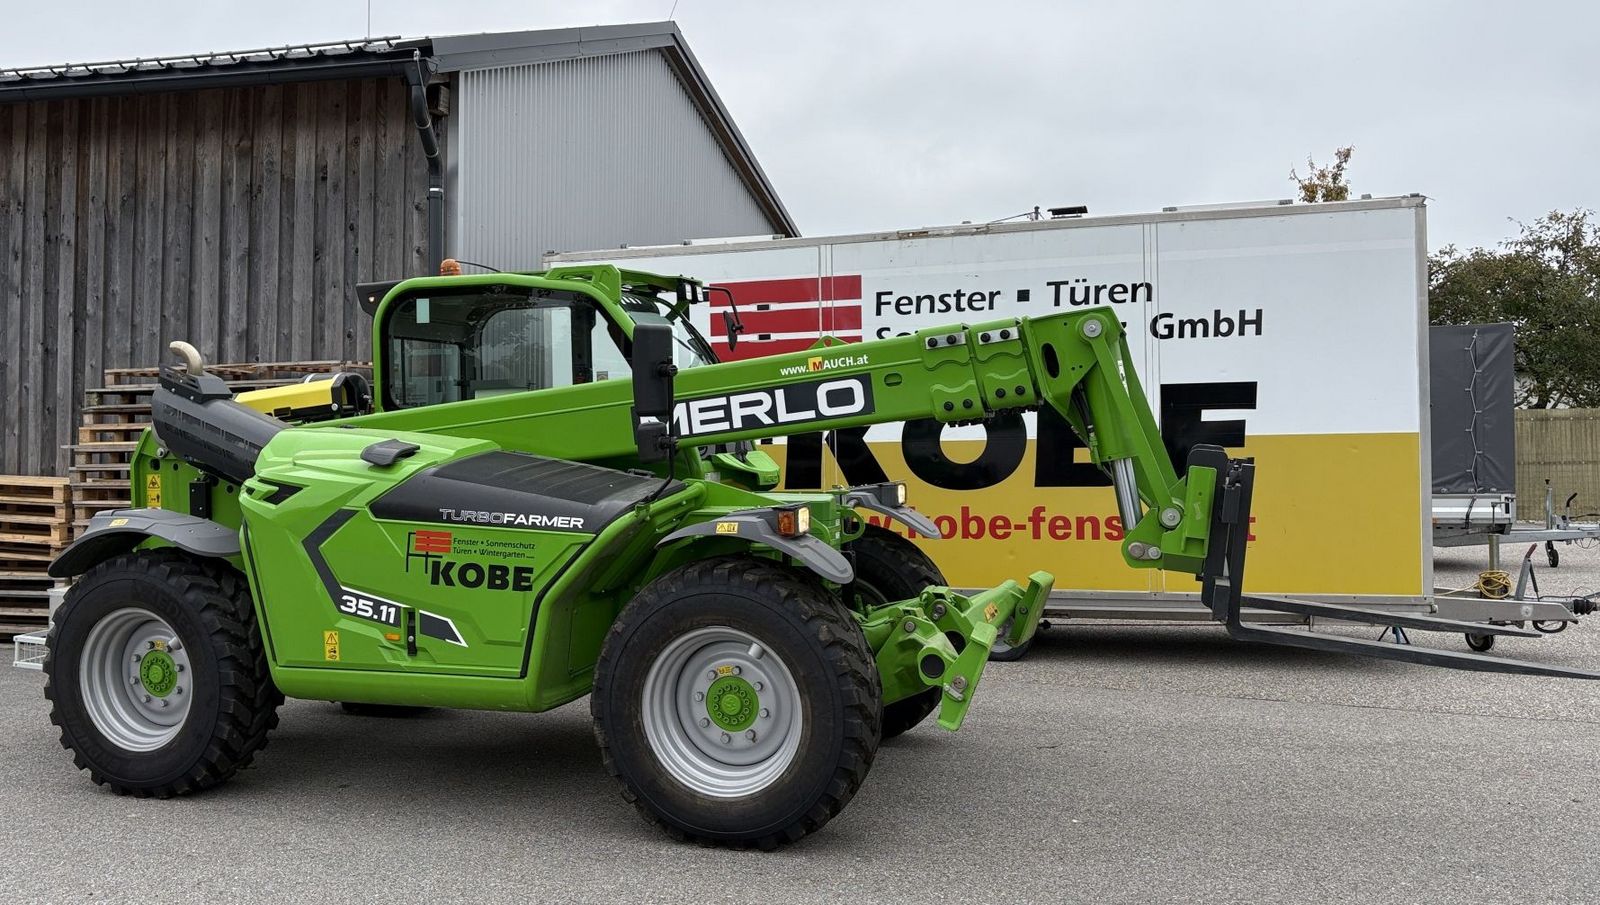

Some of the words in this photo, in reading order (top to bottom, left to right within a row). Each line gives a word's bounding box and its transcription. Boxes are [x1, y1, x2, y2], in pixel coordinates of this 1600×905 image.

[875, 286, 1001, 316] Fenster
[1046, 279, 1153, 307] Türen
[1151, 309, 1263, 340] GmbH
[780, 354, 868, 376] www.MAUCH.at
[639, 378, 865, 436] MERLO
[439, 508, 584, 529] TURBOFARMER
[453, 537, 479, 546] Fenster
[486, 539, 536, 550] Sonnenschutz
[453, 546, 473, 555] Türen
[478, 549, 526, 559] Wintergarten
[430, 560, 534, 592] KOBE
[340, 594, 396, 624] 35.11
